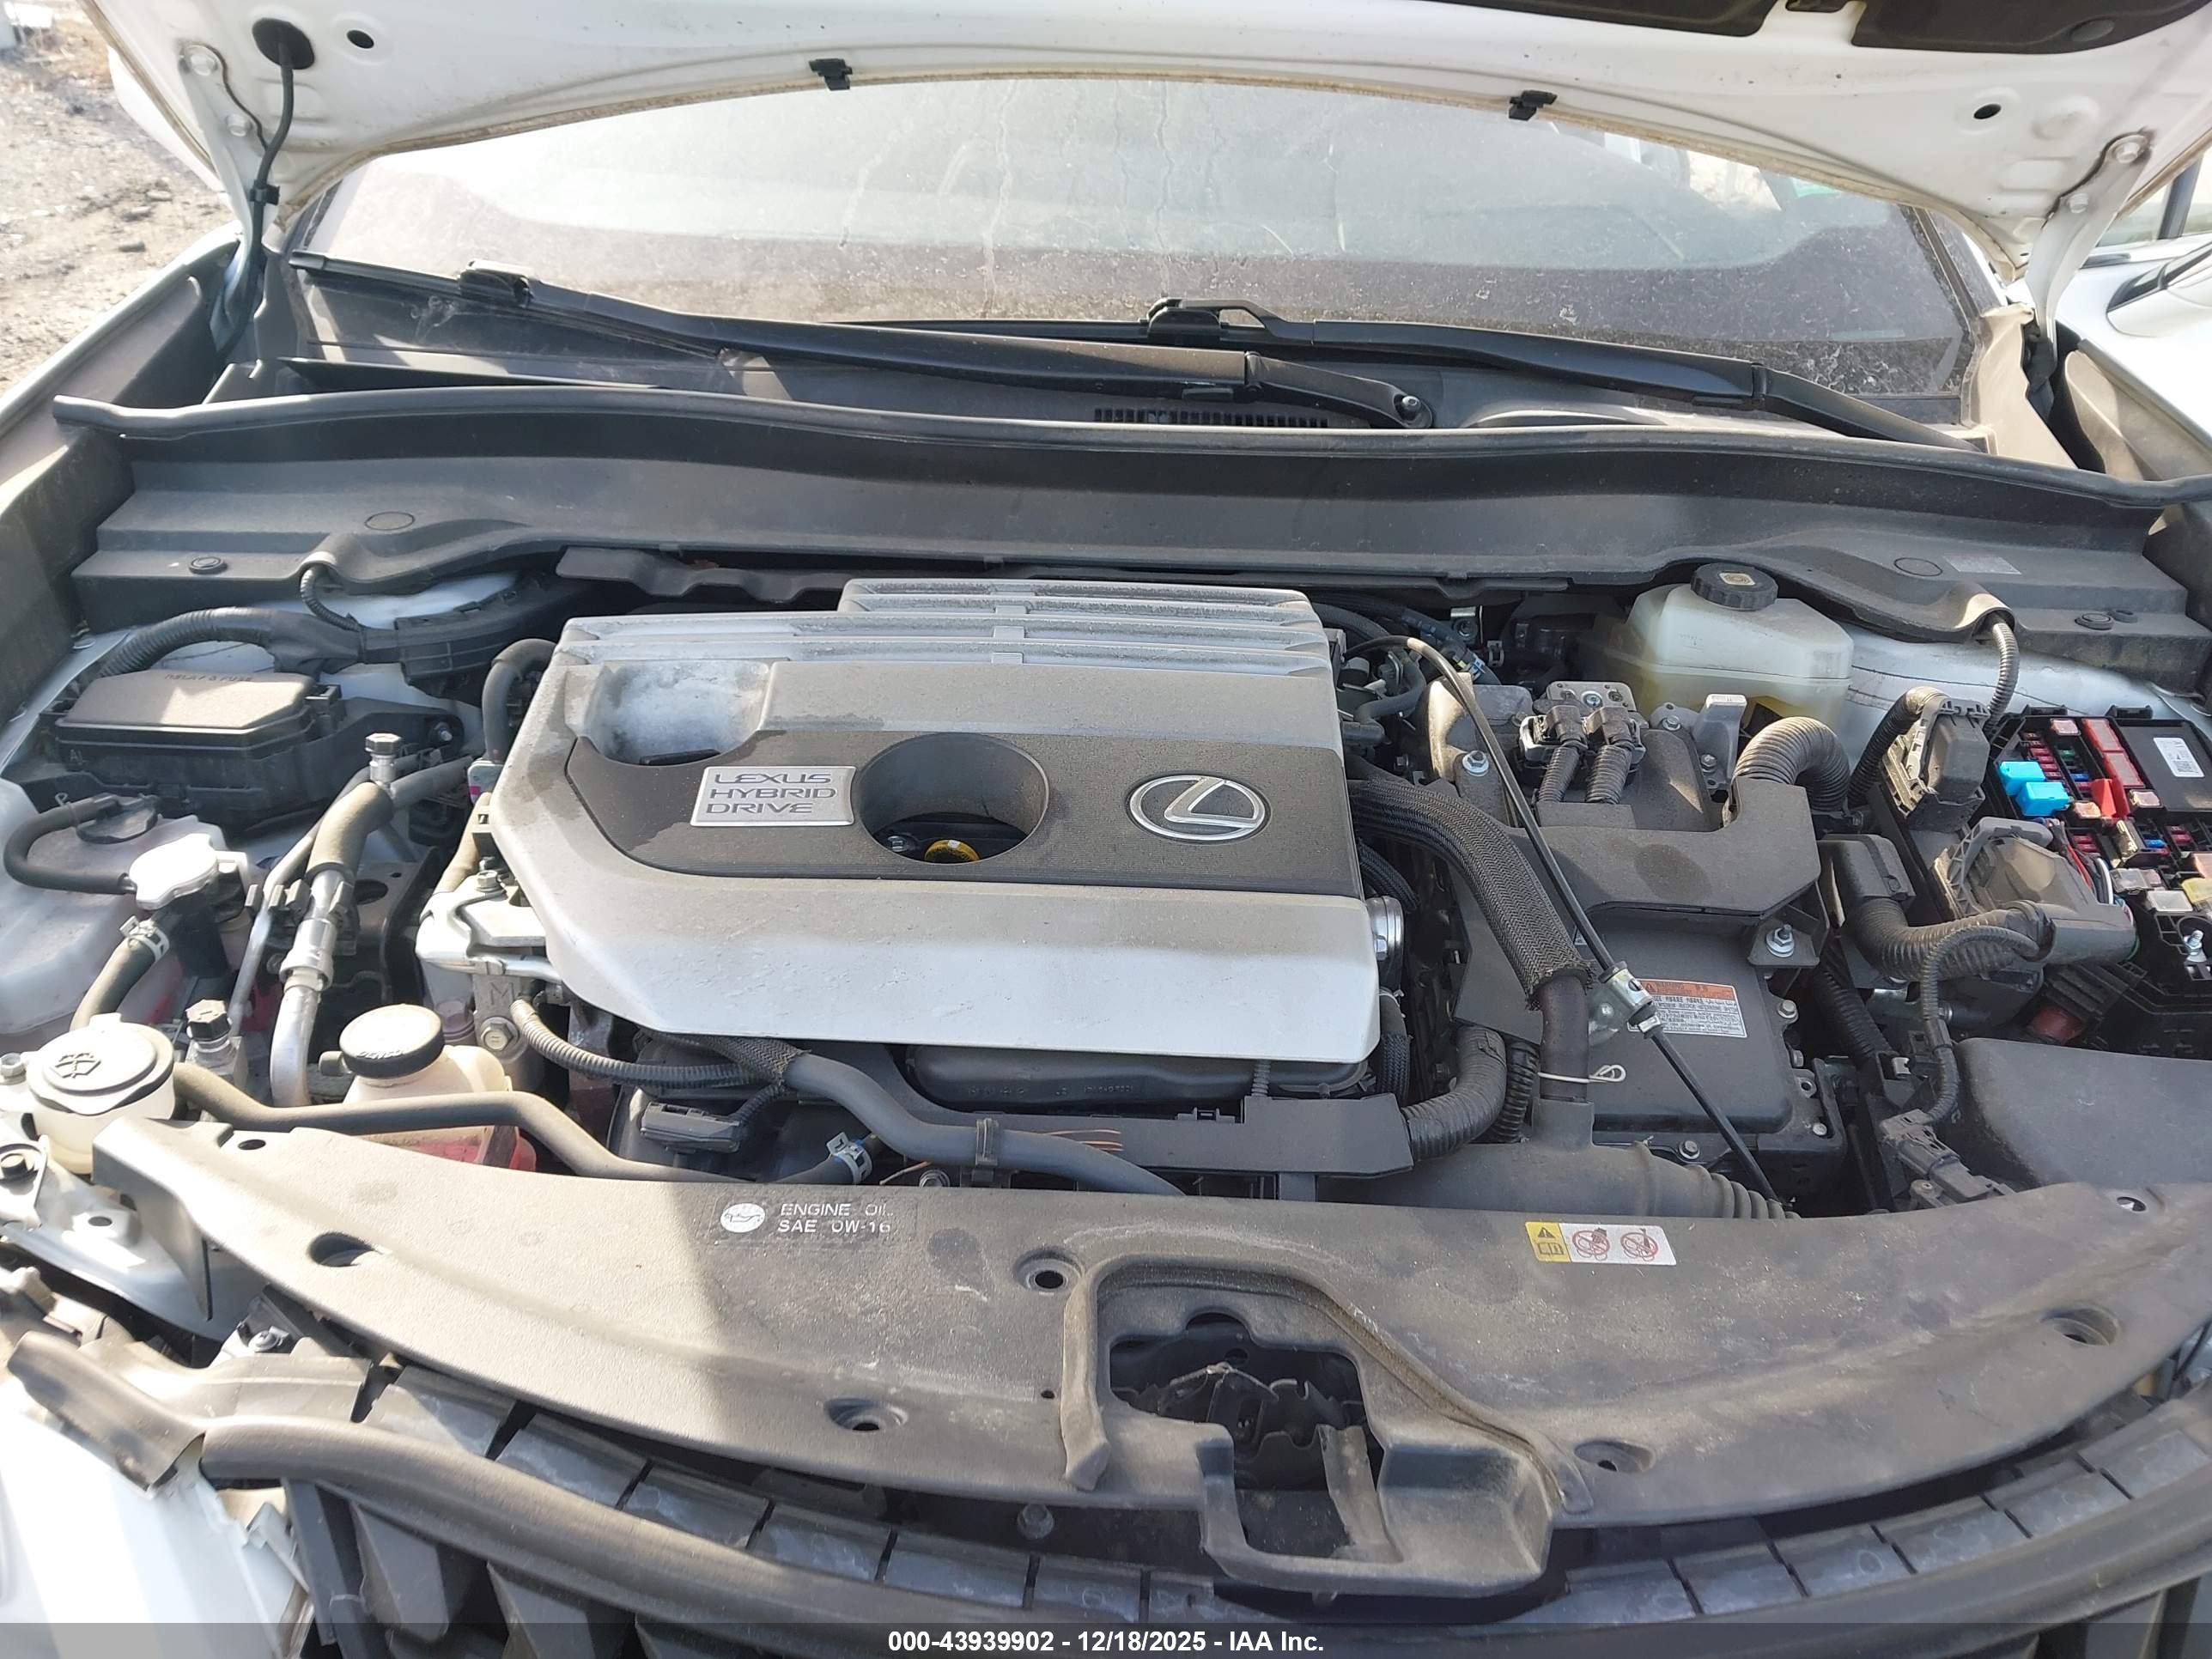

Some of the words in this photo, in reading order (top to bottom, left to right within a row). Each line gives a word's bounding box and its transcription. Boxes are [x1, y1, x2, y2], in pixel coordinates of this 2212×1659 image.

[714, 774, 832, 784] LEXUS
[710, 788, 836, 799] HYBRID
[706, 803, 814, 814] DRIVE
[781, 1202, 852, 1217] ENGINE
[777, 1219, 817, 1233] SAE
[831, 1219, 892, 1234] 0W-16
